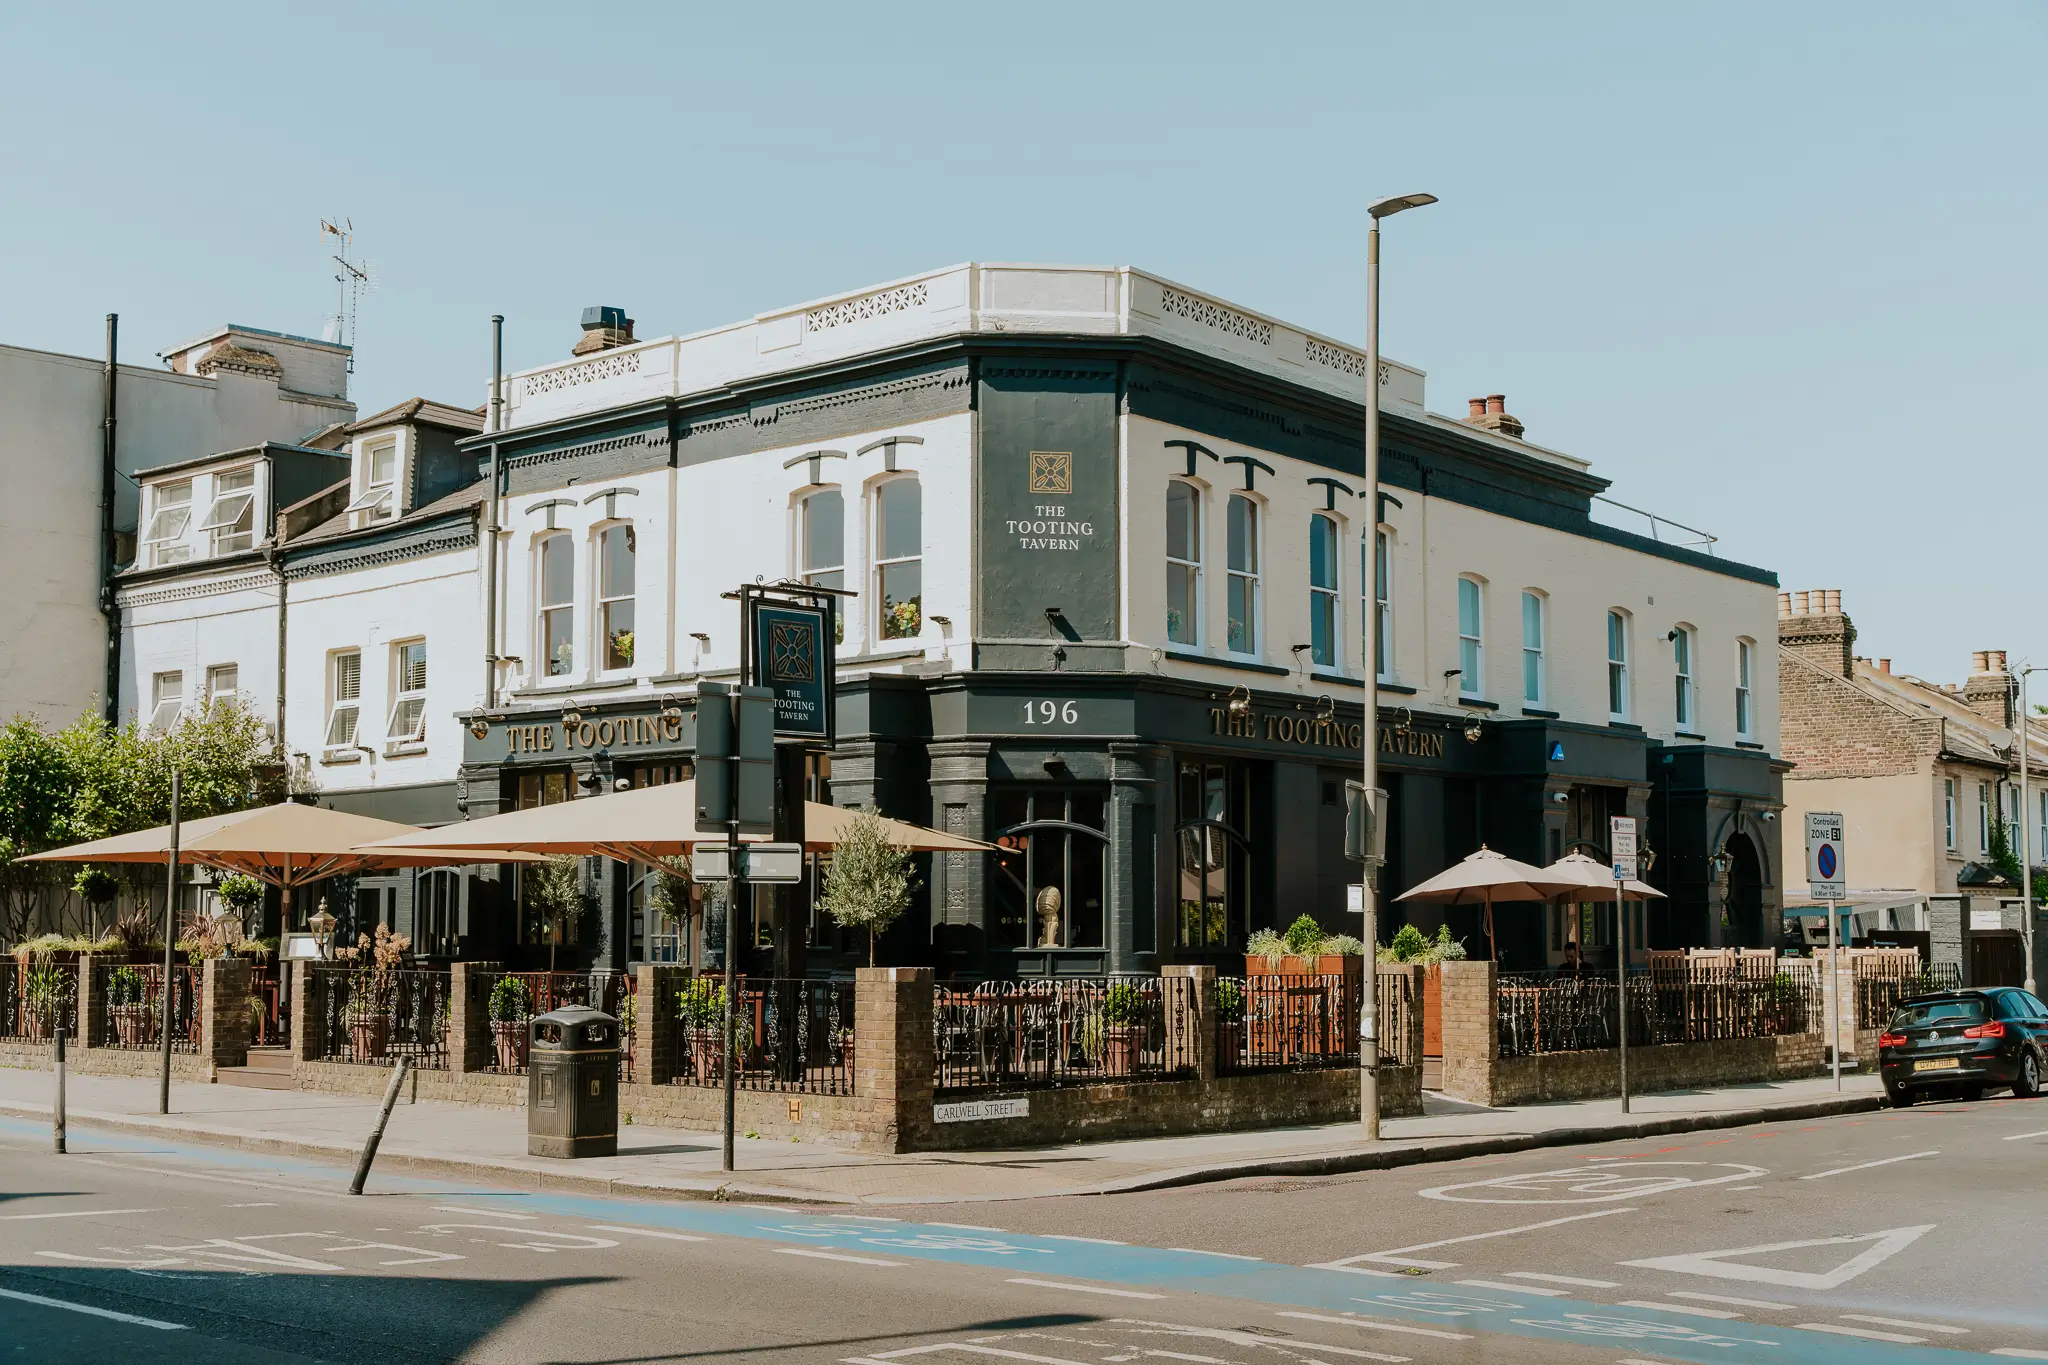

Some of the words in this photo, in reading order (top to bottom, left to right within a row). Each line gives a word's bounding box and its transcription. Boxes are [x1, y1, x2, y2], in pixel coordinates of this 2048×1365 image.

[1035, 505, 1065, 517] THE
[1006, 520, 1094, 536] TOOTING
[1020, 538, 1079, 551] TAVERN
[786, 689, 801, 698] THE
[773, 698, 815, 711] TOOTING
[780, 711, 809, 721] TAVERN
[1023, 700, 1078, 725] 196
[506, 725, 553, 752] THE
[1211, 708, 1256, 738] THE
[1264, 714, 1362, 749] TOOTING
[1376, 727, 1444, 758] AVERN
[1812, 817, 1839, 826] Controlled
[1811, 829, 1830, 839] ZONE
[1832, 829, 1840, 840] E1
[788, 1100, 800, 1121] H
[937, 1105, 981, 1120] CARLWELL
[984, 1102, 1015, 1116] STREET
